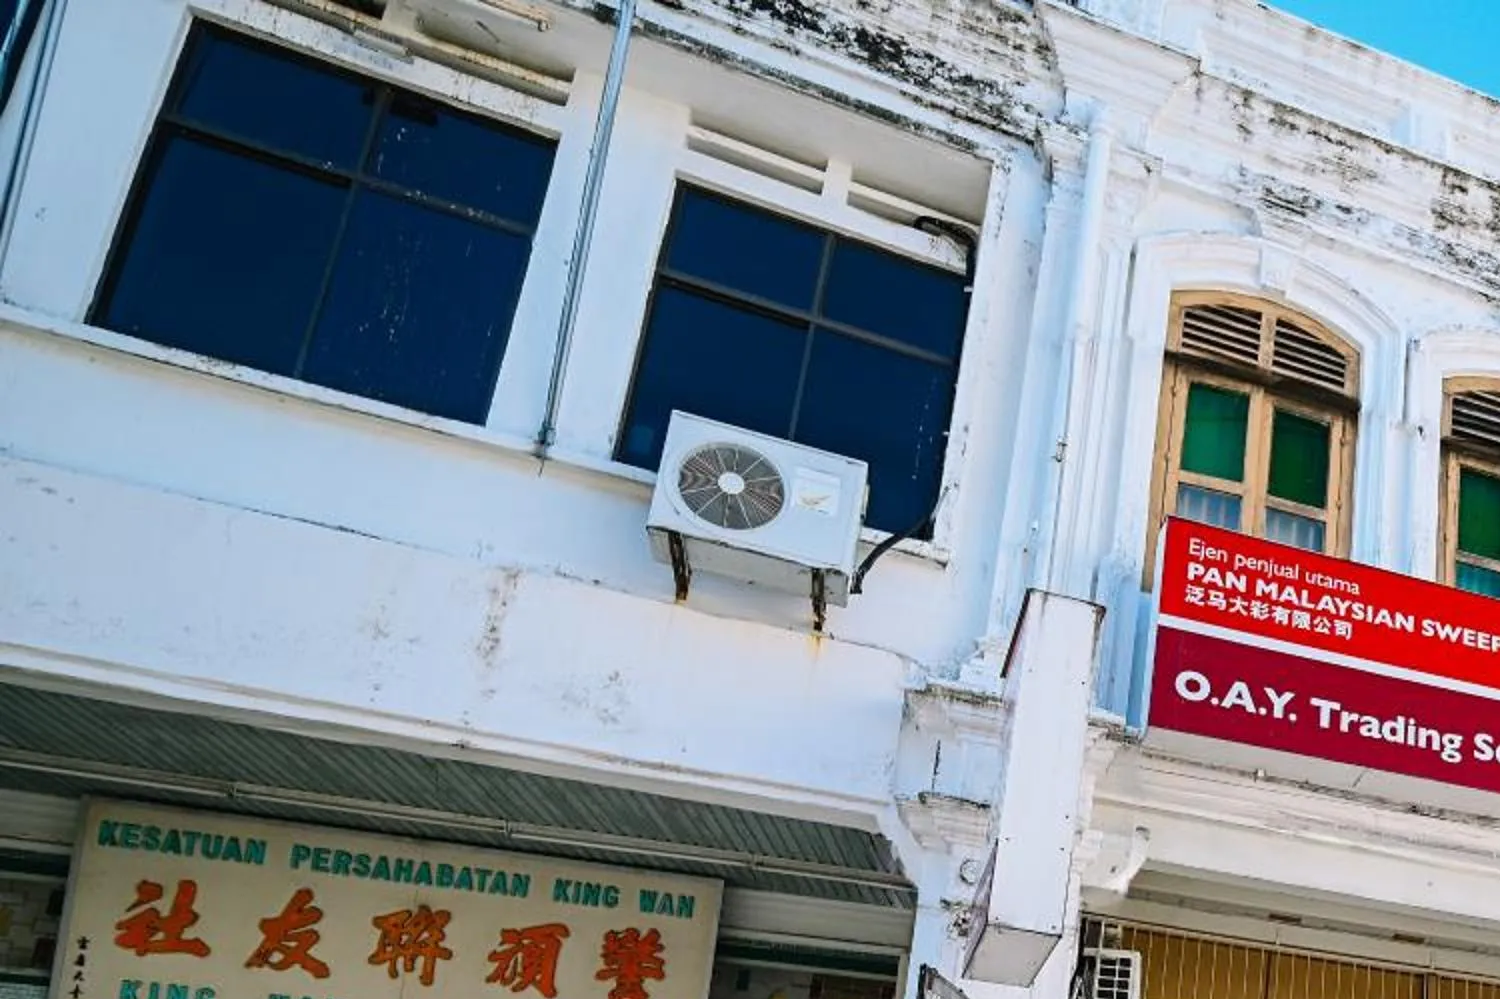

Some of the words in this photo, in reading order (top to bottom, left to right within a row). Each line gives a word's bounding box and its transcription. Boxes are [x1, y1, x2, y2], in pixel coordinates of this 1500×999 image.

[1187, 561, 1247, 593] PAN
[1255, 580, 1415, 633] MALAYSIAN
[1188, 538, 1228, 563] Ejen
[1234, 553, 1299, 581] penjual
[1305, 570, 1360, 596] utama
[1185, 584, 1353, 640] 泛马大彩有限公司
[1175, 670, 1298, 722] O.A.Y.
[1310, 698, 1464, 764] Trading
[98, 820, 267, 865] KESATUAN
[290, 843, 530, 898] PERSAHABATAN
[553, 877, 620, 909] KING
[639, 889, 695, 919] WAN
